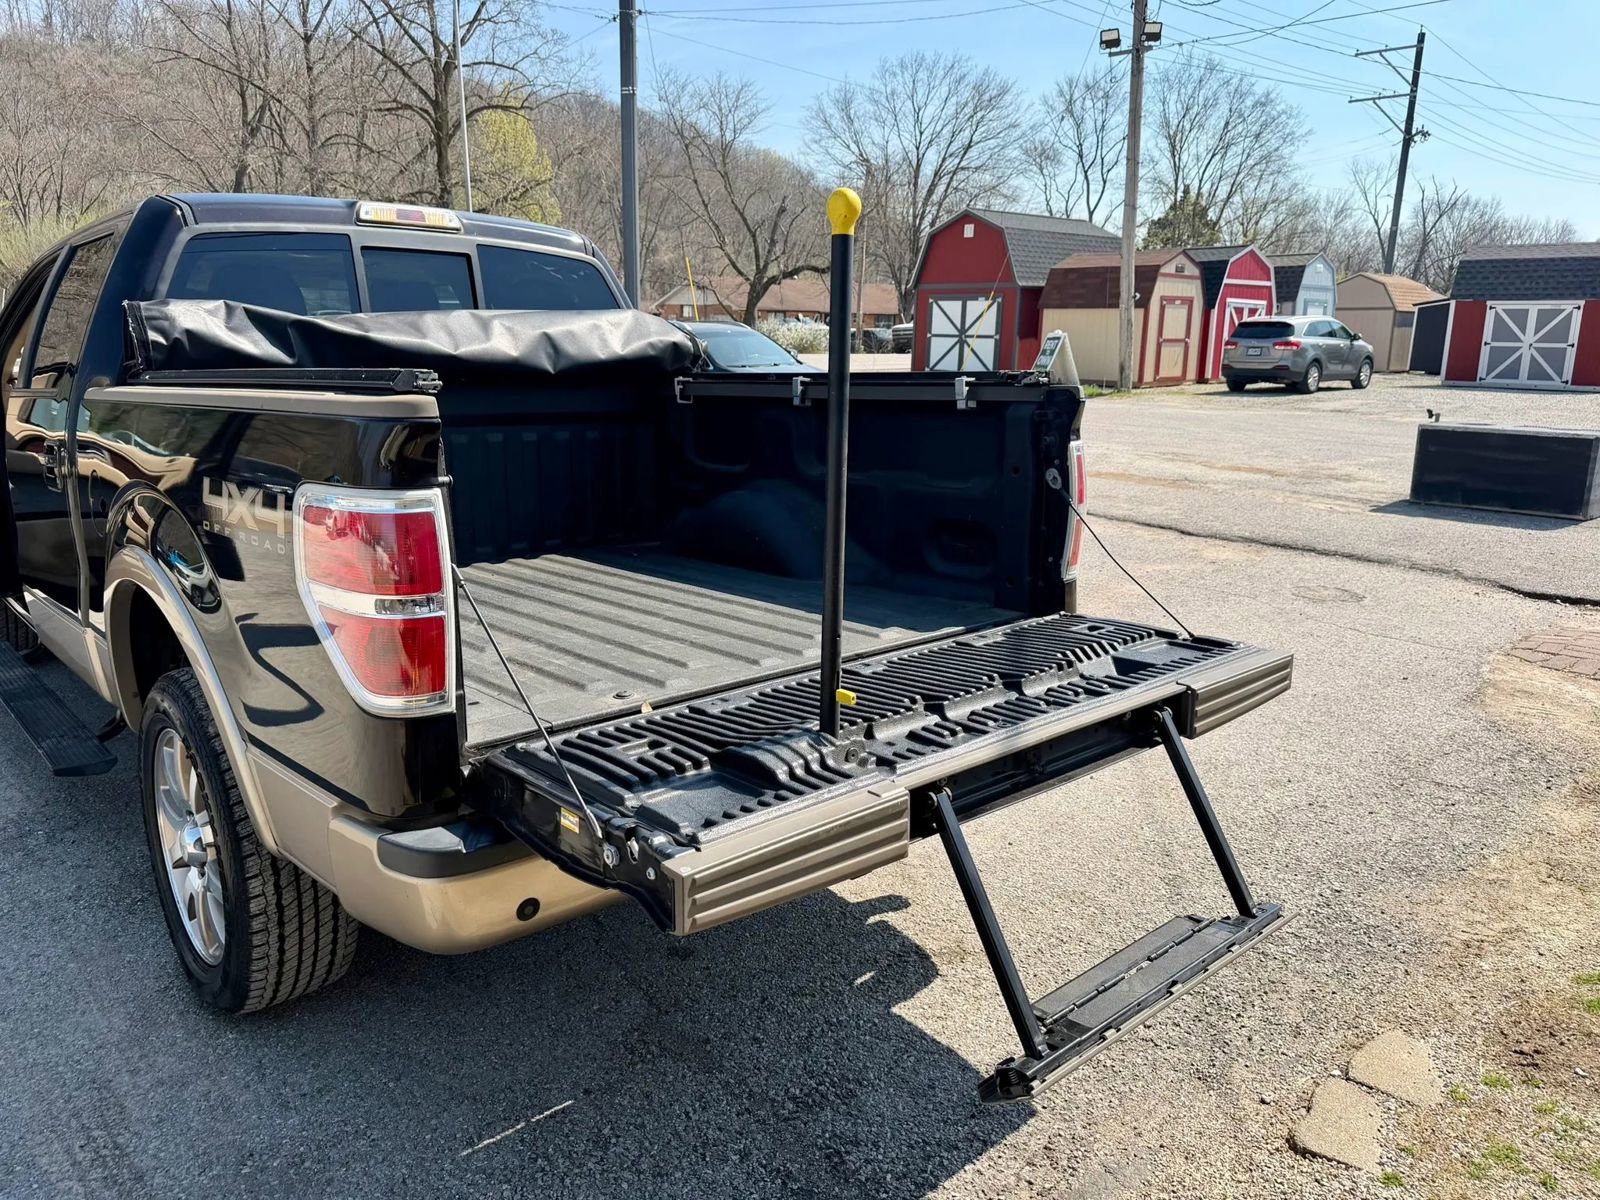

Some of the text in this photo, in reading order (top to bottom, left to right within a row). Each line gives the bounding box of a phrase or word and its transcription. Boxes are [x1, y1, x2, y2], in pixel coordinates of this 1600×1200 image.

[202, 476, 286, 539] 4X4
[203, 520, 286, 554] OFF ROAD
